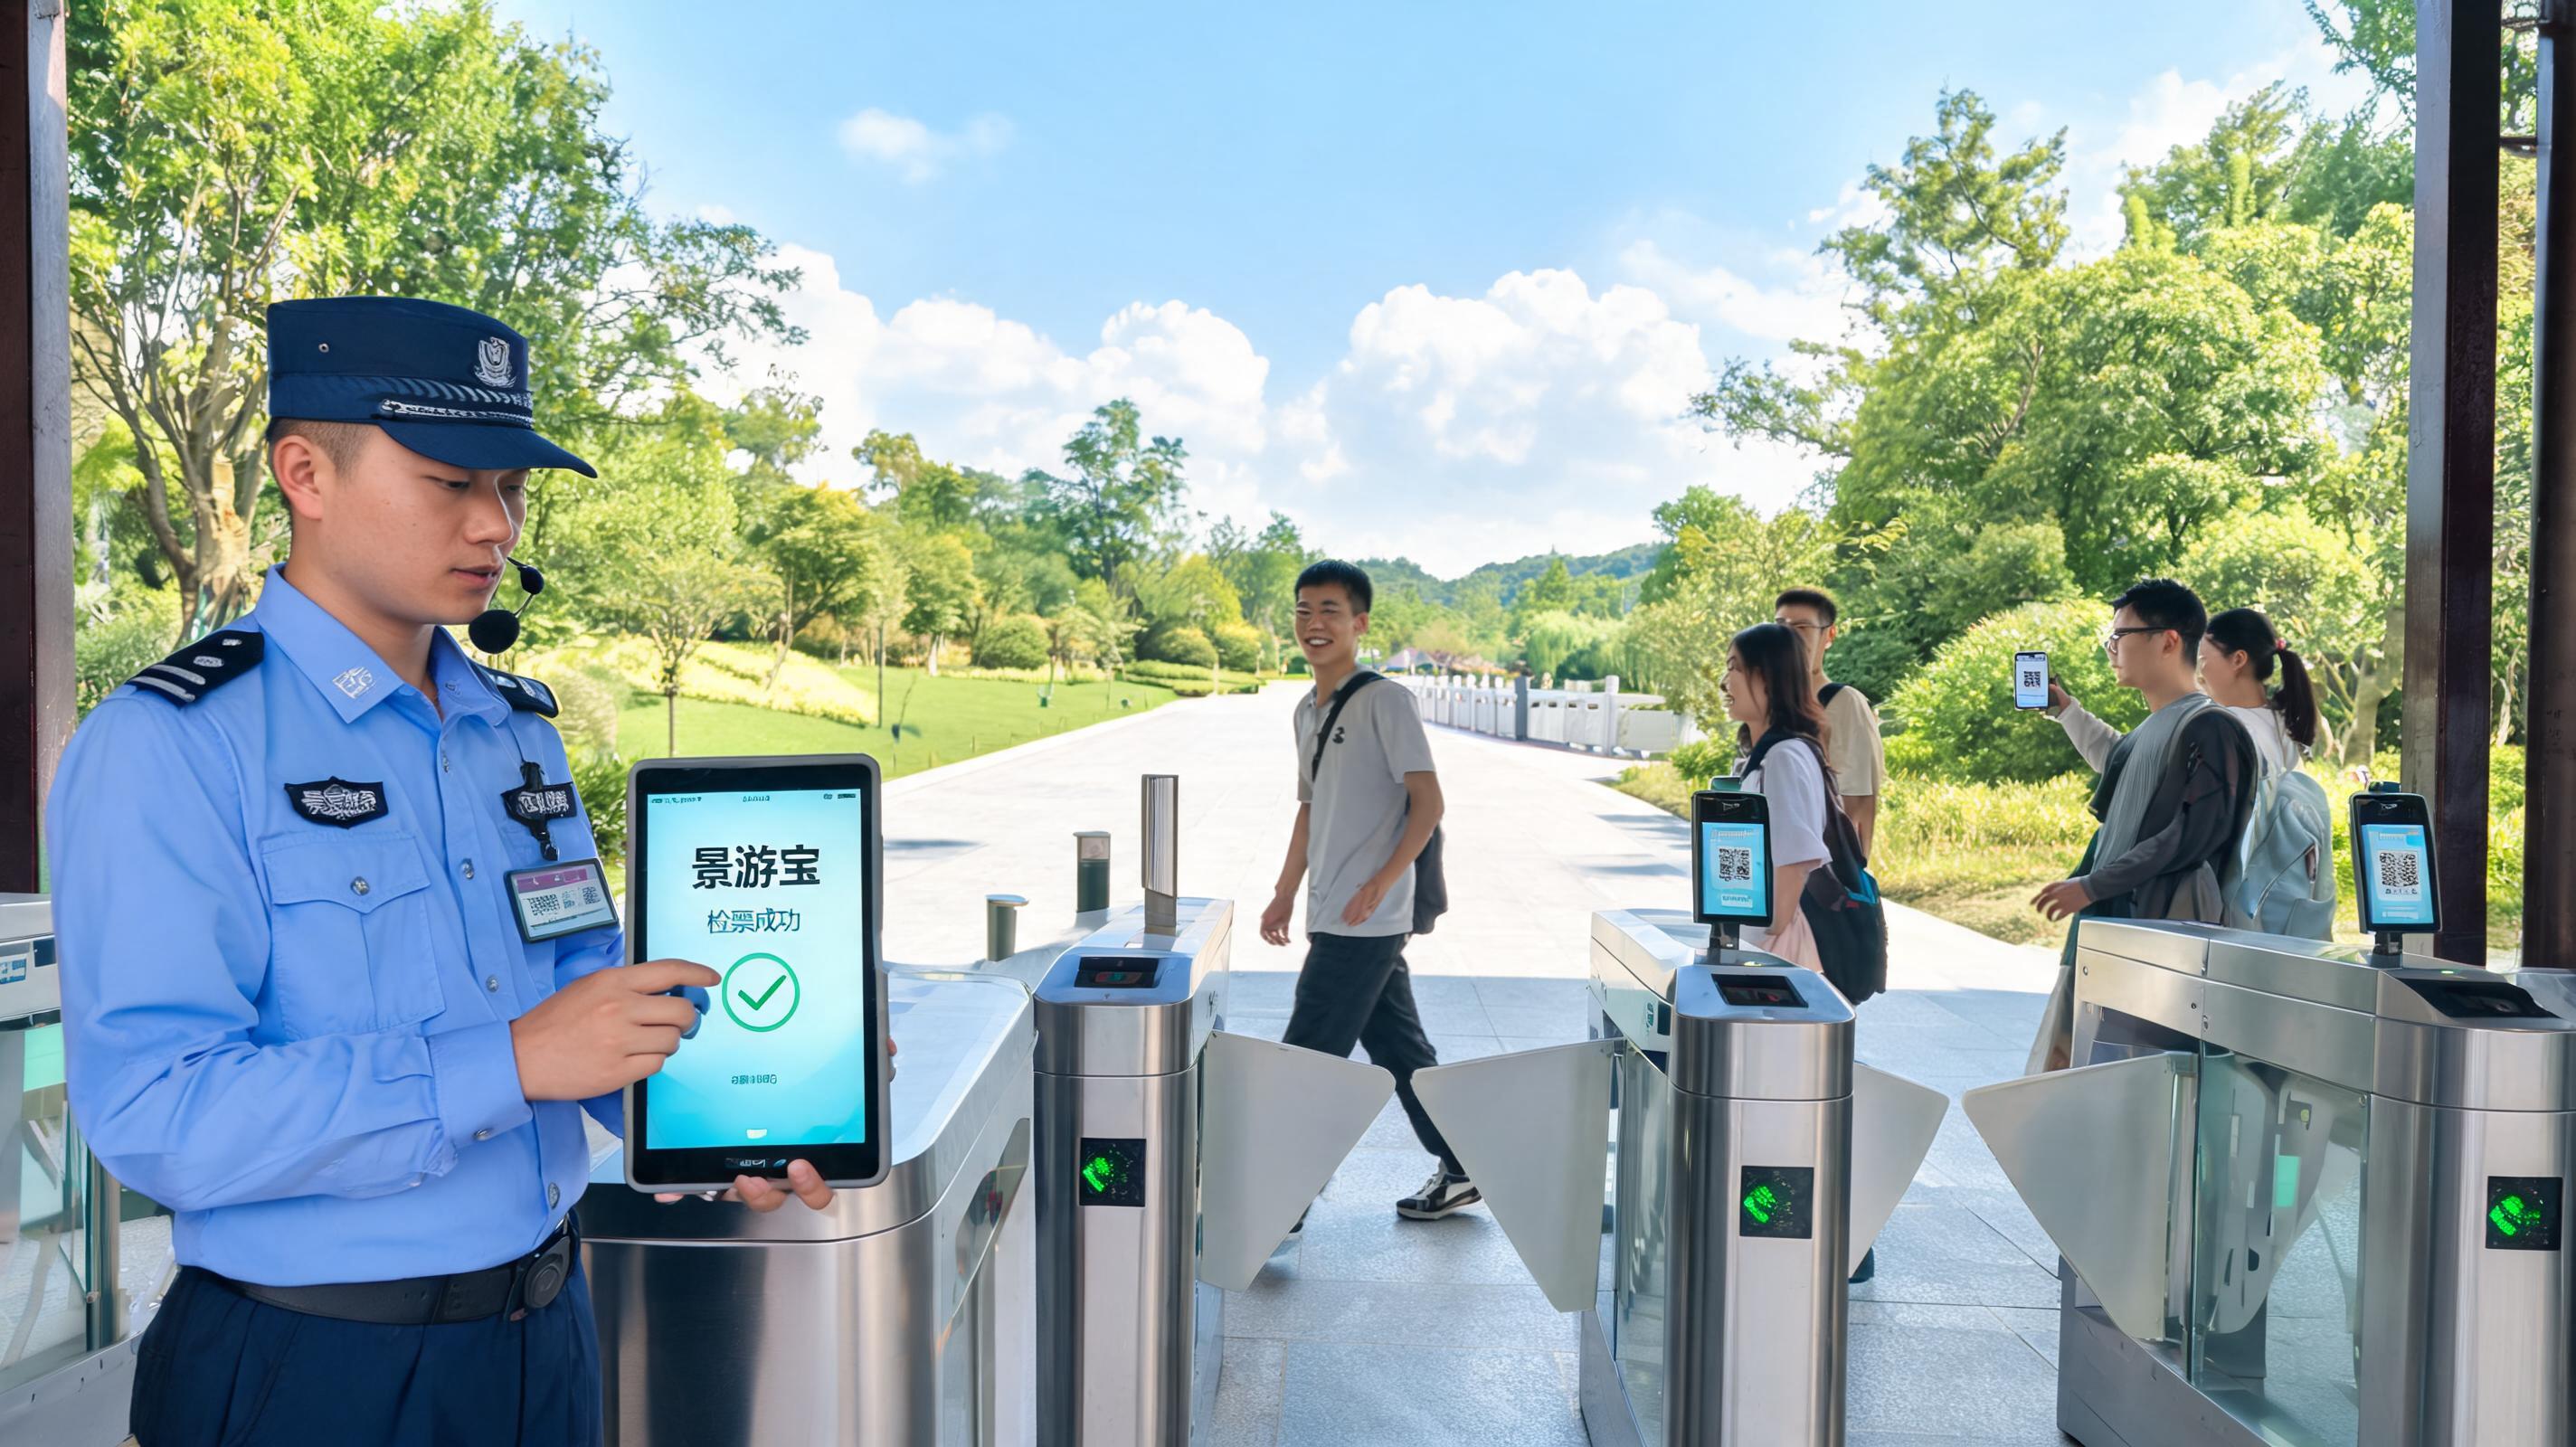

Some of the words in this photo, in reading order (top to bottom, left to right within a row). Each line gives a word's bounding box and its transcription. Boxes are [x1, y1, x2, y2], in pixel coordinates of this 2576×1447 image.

[692, 844, 820, 889] 景游宝
[707, 907, 800, 933] 检票成功
